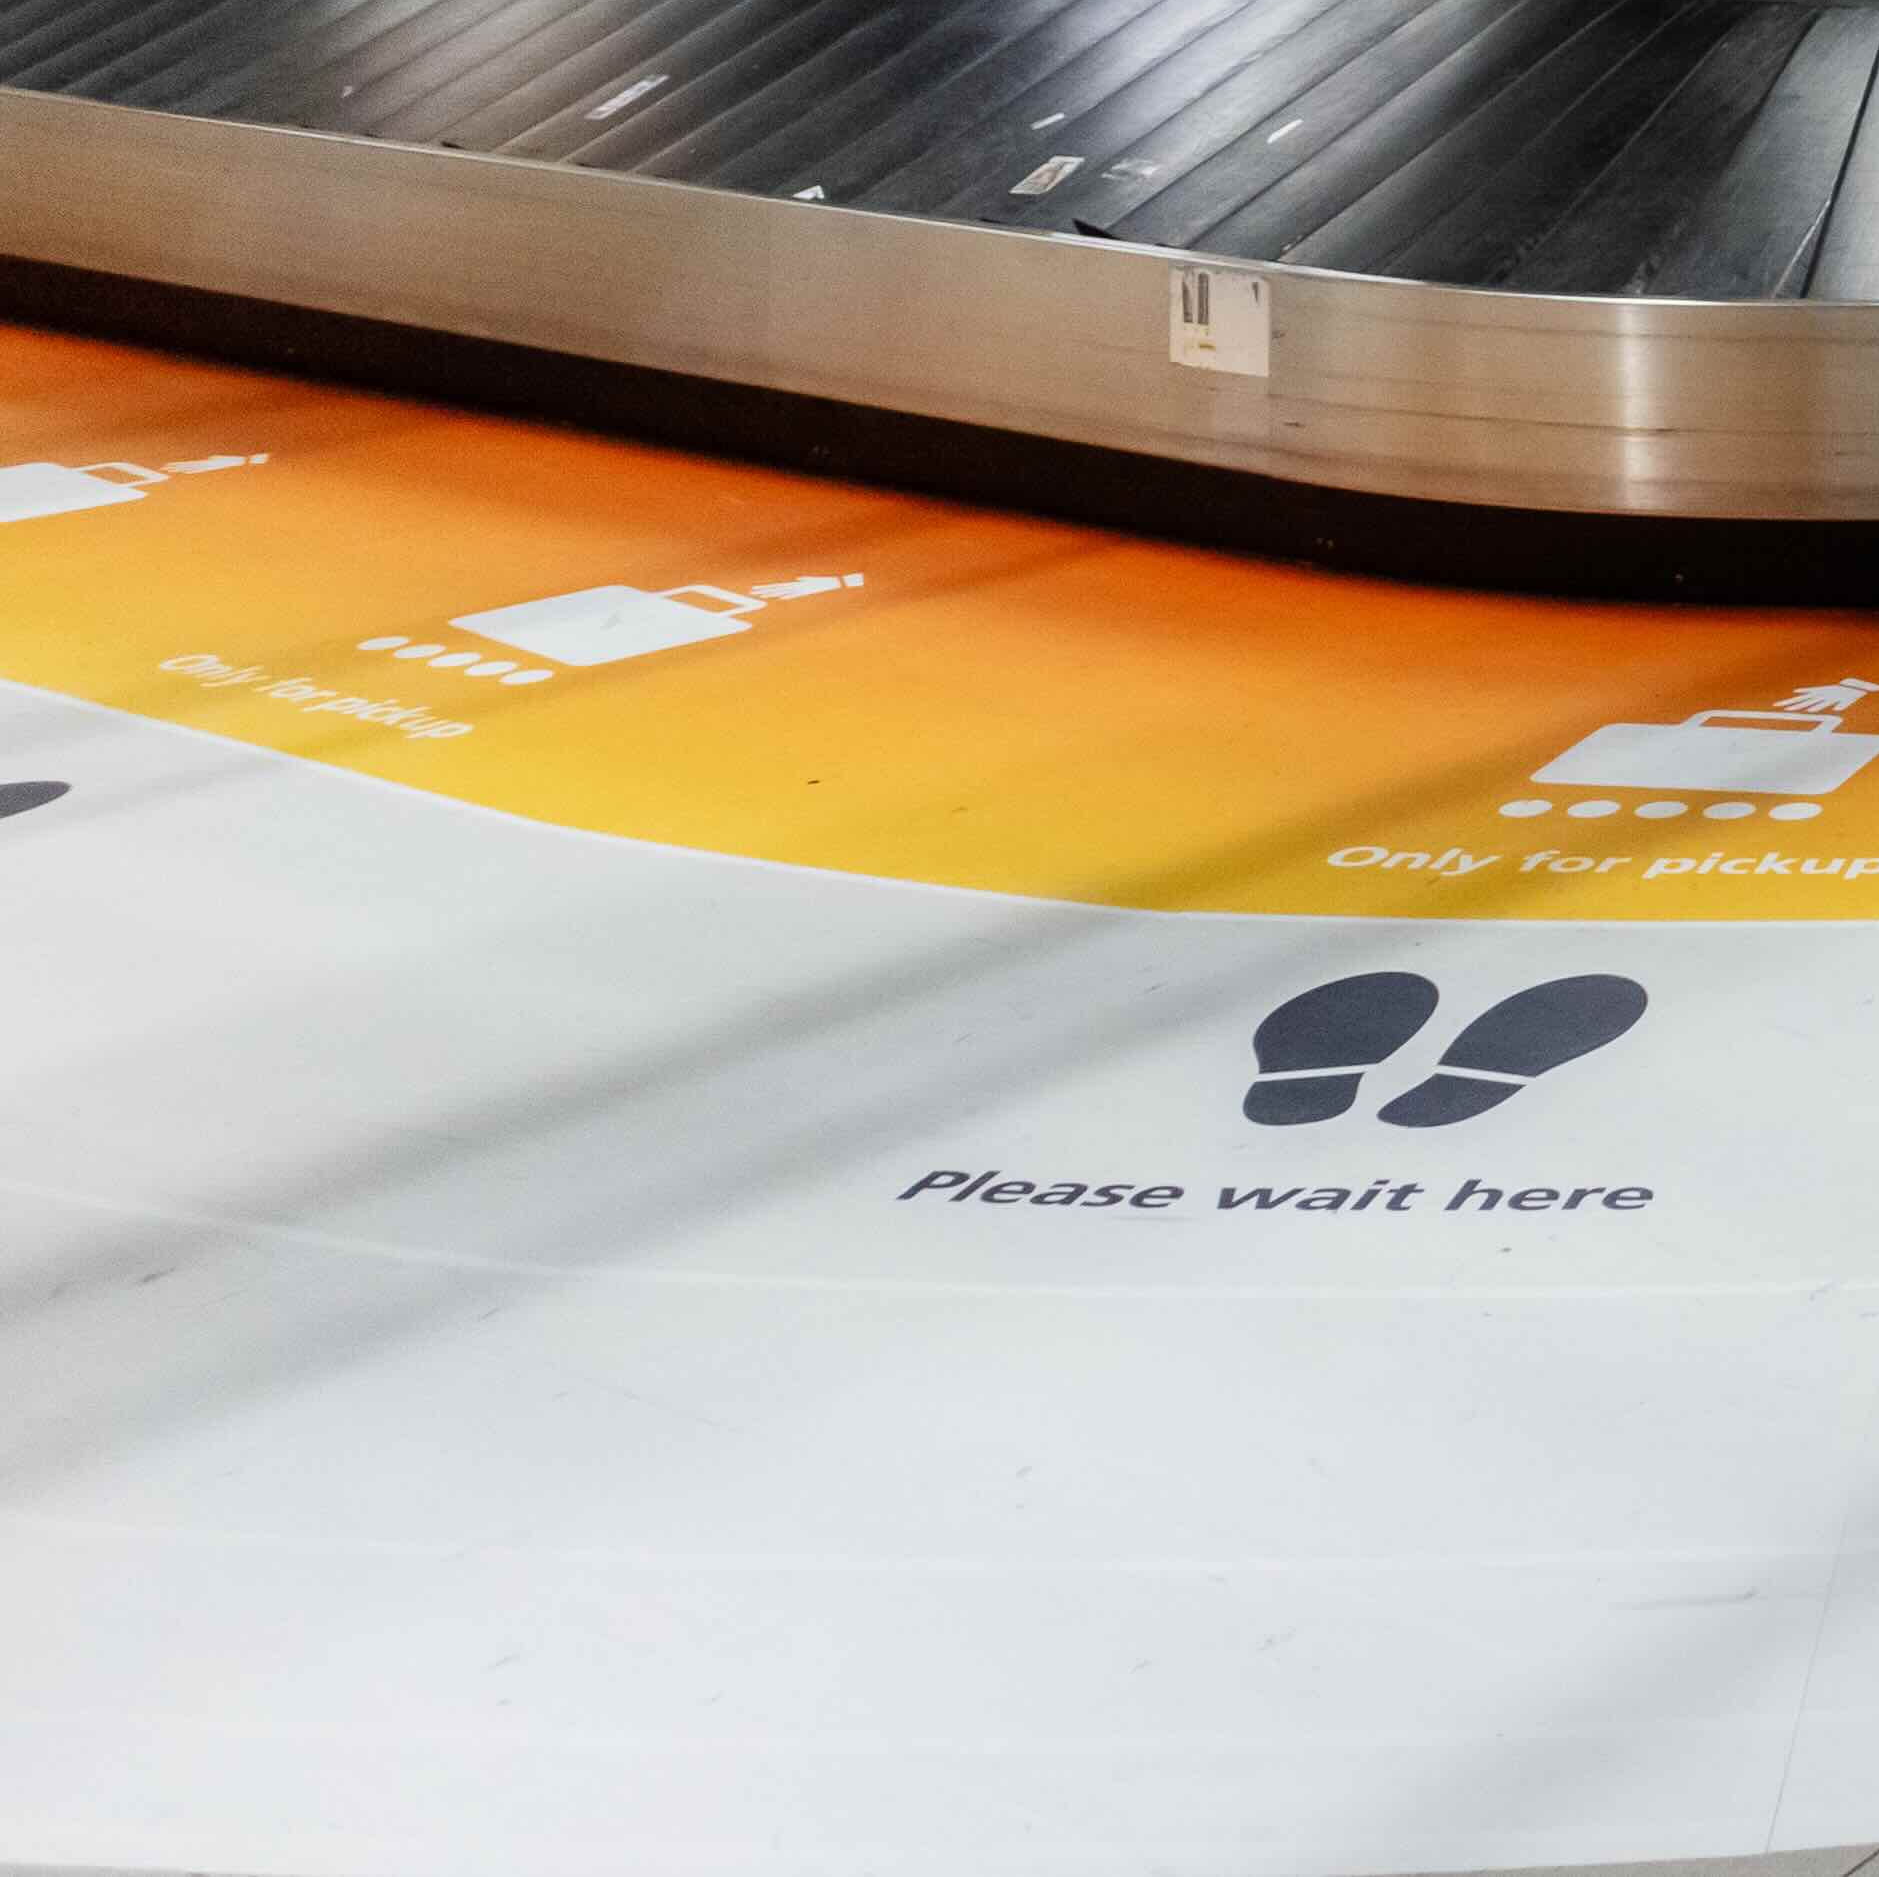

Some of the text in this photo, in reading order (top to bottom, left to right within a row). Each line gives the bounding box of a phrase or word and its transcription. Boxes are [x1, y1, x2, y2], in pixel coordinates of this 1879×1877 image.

[158, 653, 474, 739] Only for pickup
[1327, 845, 1504, 878] Only
[1519, 849, 1634, 875] for
[896, 1169, 1655, 1213] Please wait here
